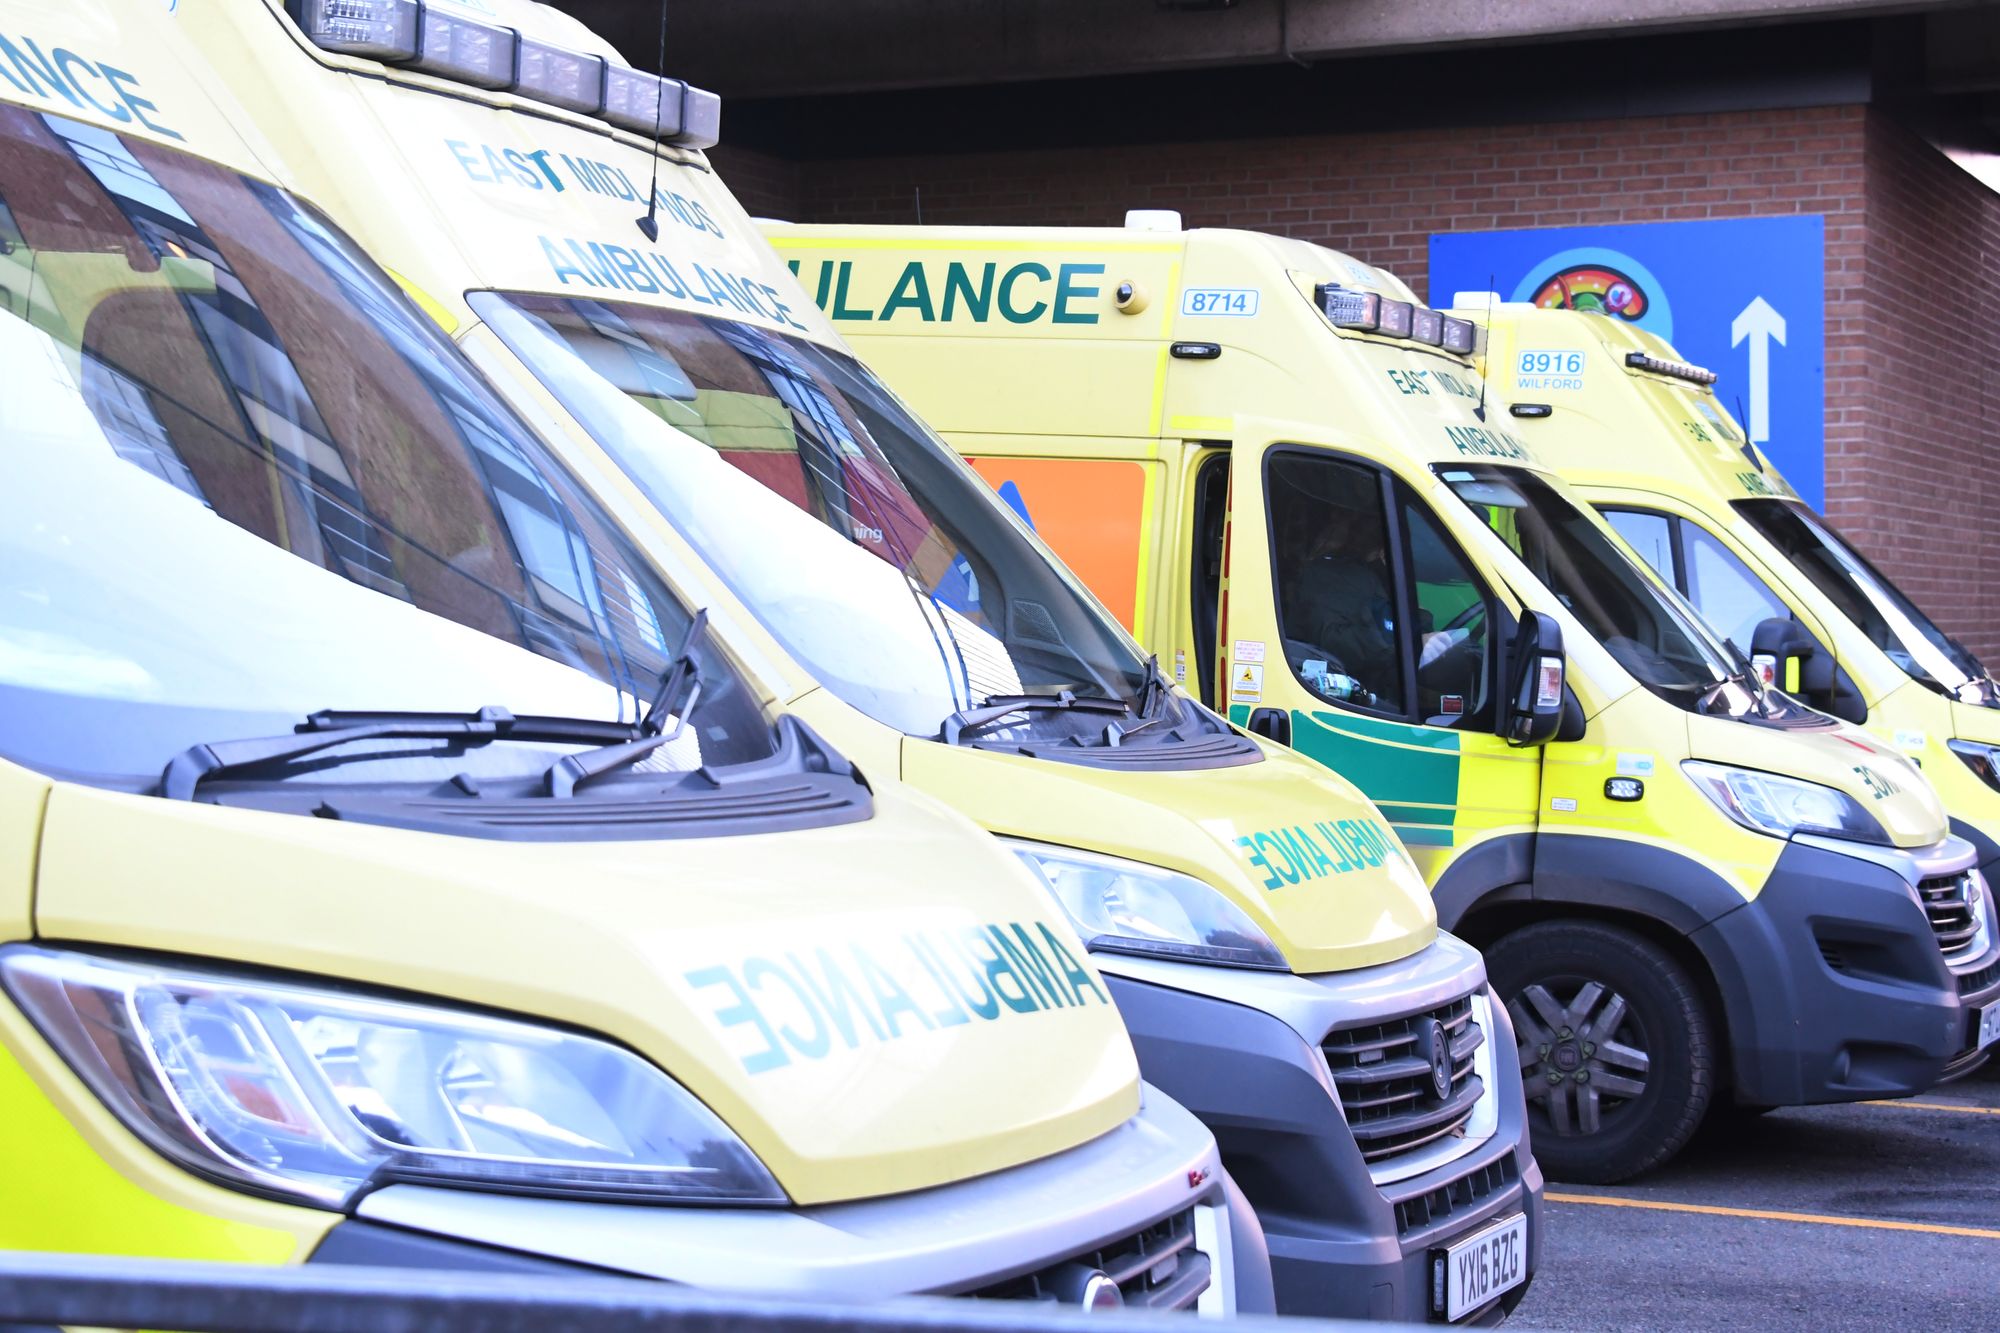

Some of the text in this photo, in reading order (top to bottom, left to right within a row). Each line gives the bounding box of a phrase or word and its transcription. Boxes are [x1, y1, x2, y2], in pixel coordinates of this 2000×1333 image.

[444, 138, 726, 240] EAST MIDLNDS
[537, 234, 809, 332] AMBULANCE
[1191, 292, 1248, 314] 8714
[1517, 377, 1583, 391] WILFORD
[1521, 353, 1581, 373] 8916
[1459, 1229, 1518, 1307] YX16 BZG
